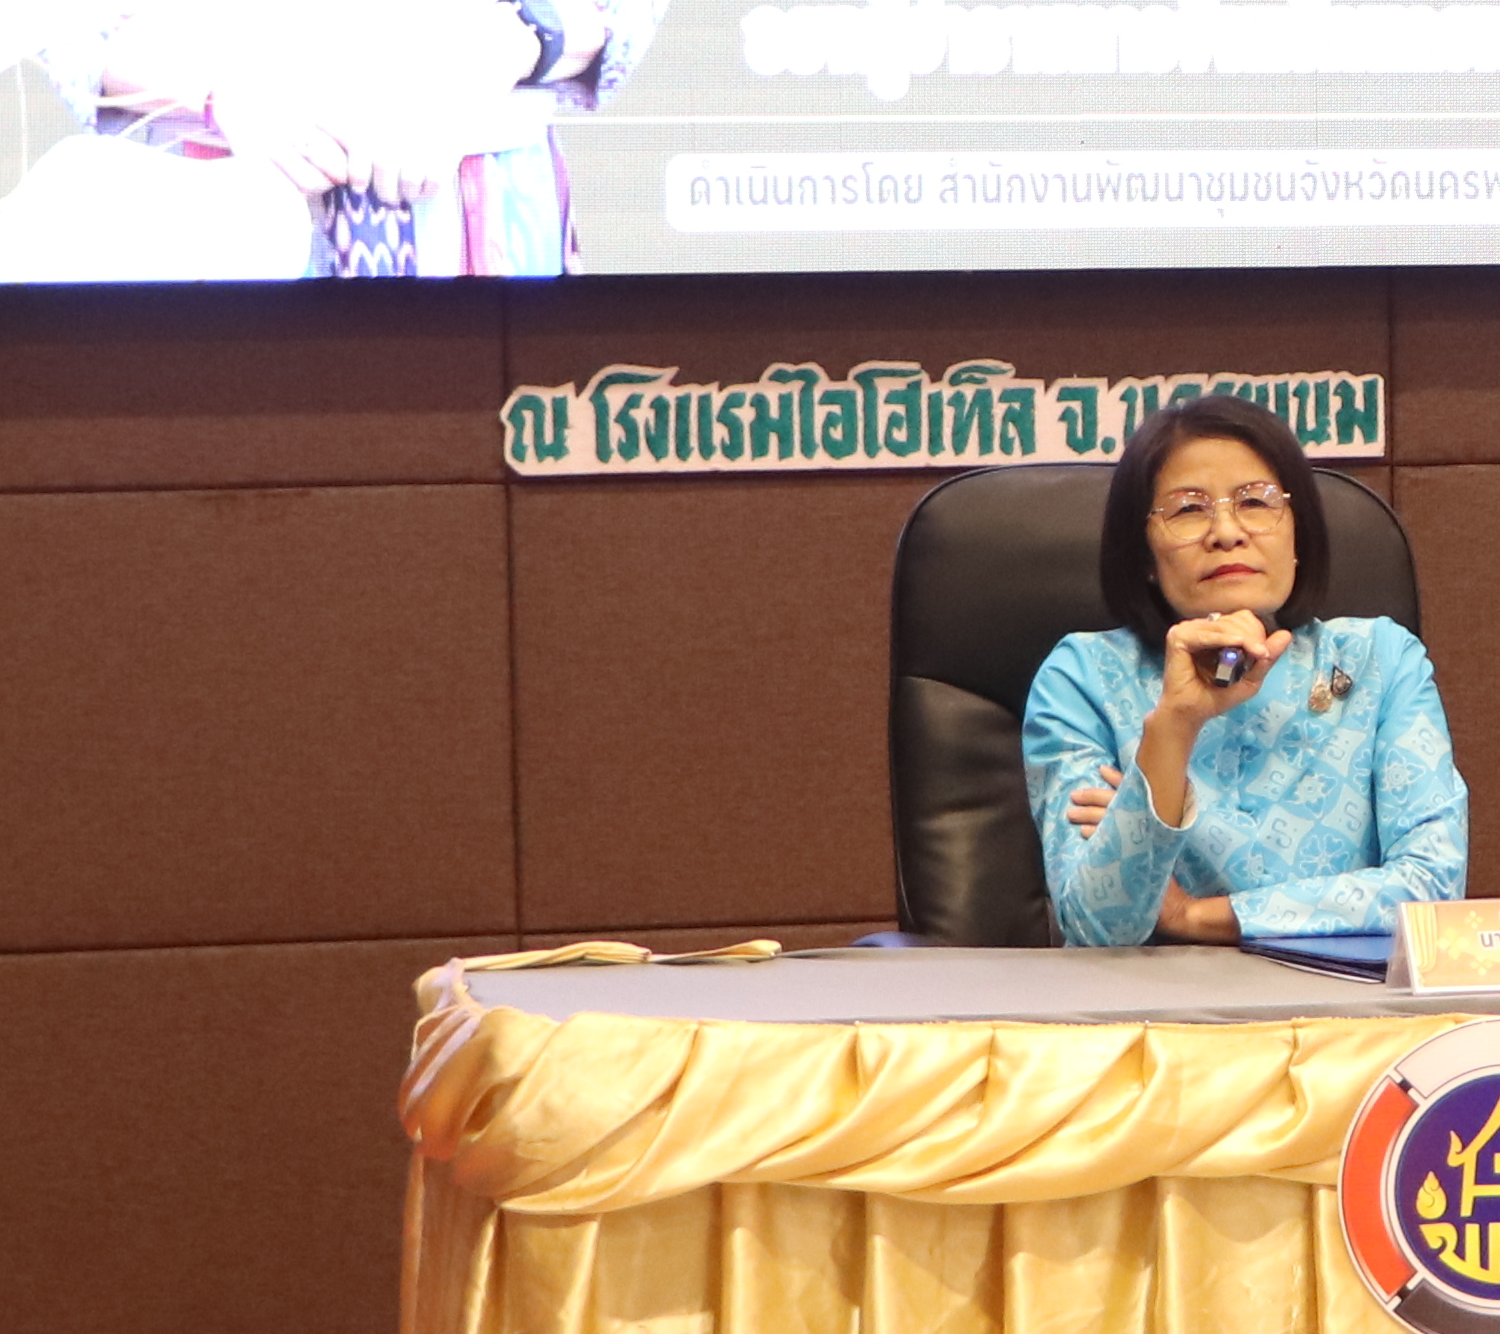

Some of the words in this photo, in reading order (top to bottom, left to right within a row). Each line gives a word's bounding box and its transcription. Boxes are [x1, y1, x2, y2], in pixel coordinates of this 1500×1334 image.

[688, 155, 925, 208] ดำเนินการโดย
[508, 395, 569, 461] ณ
[1057, 380, 1379, 454] จ.นนม
